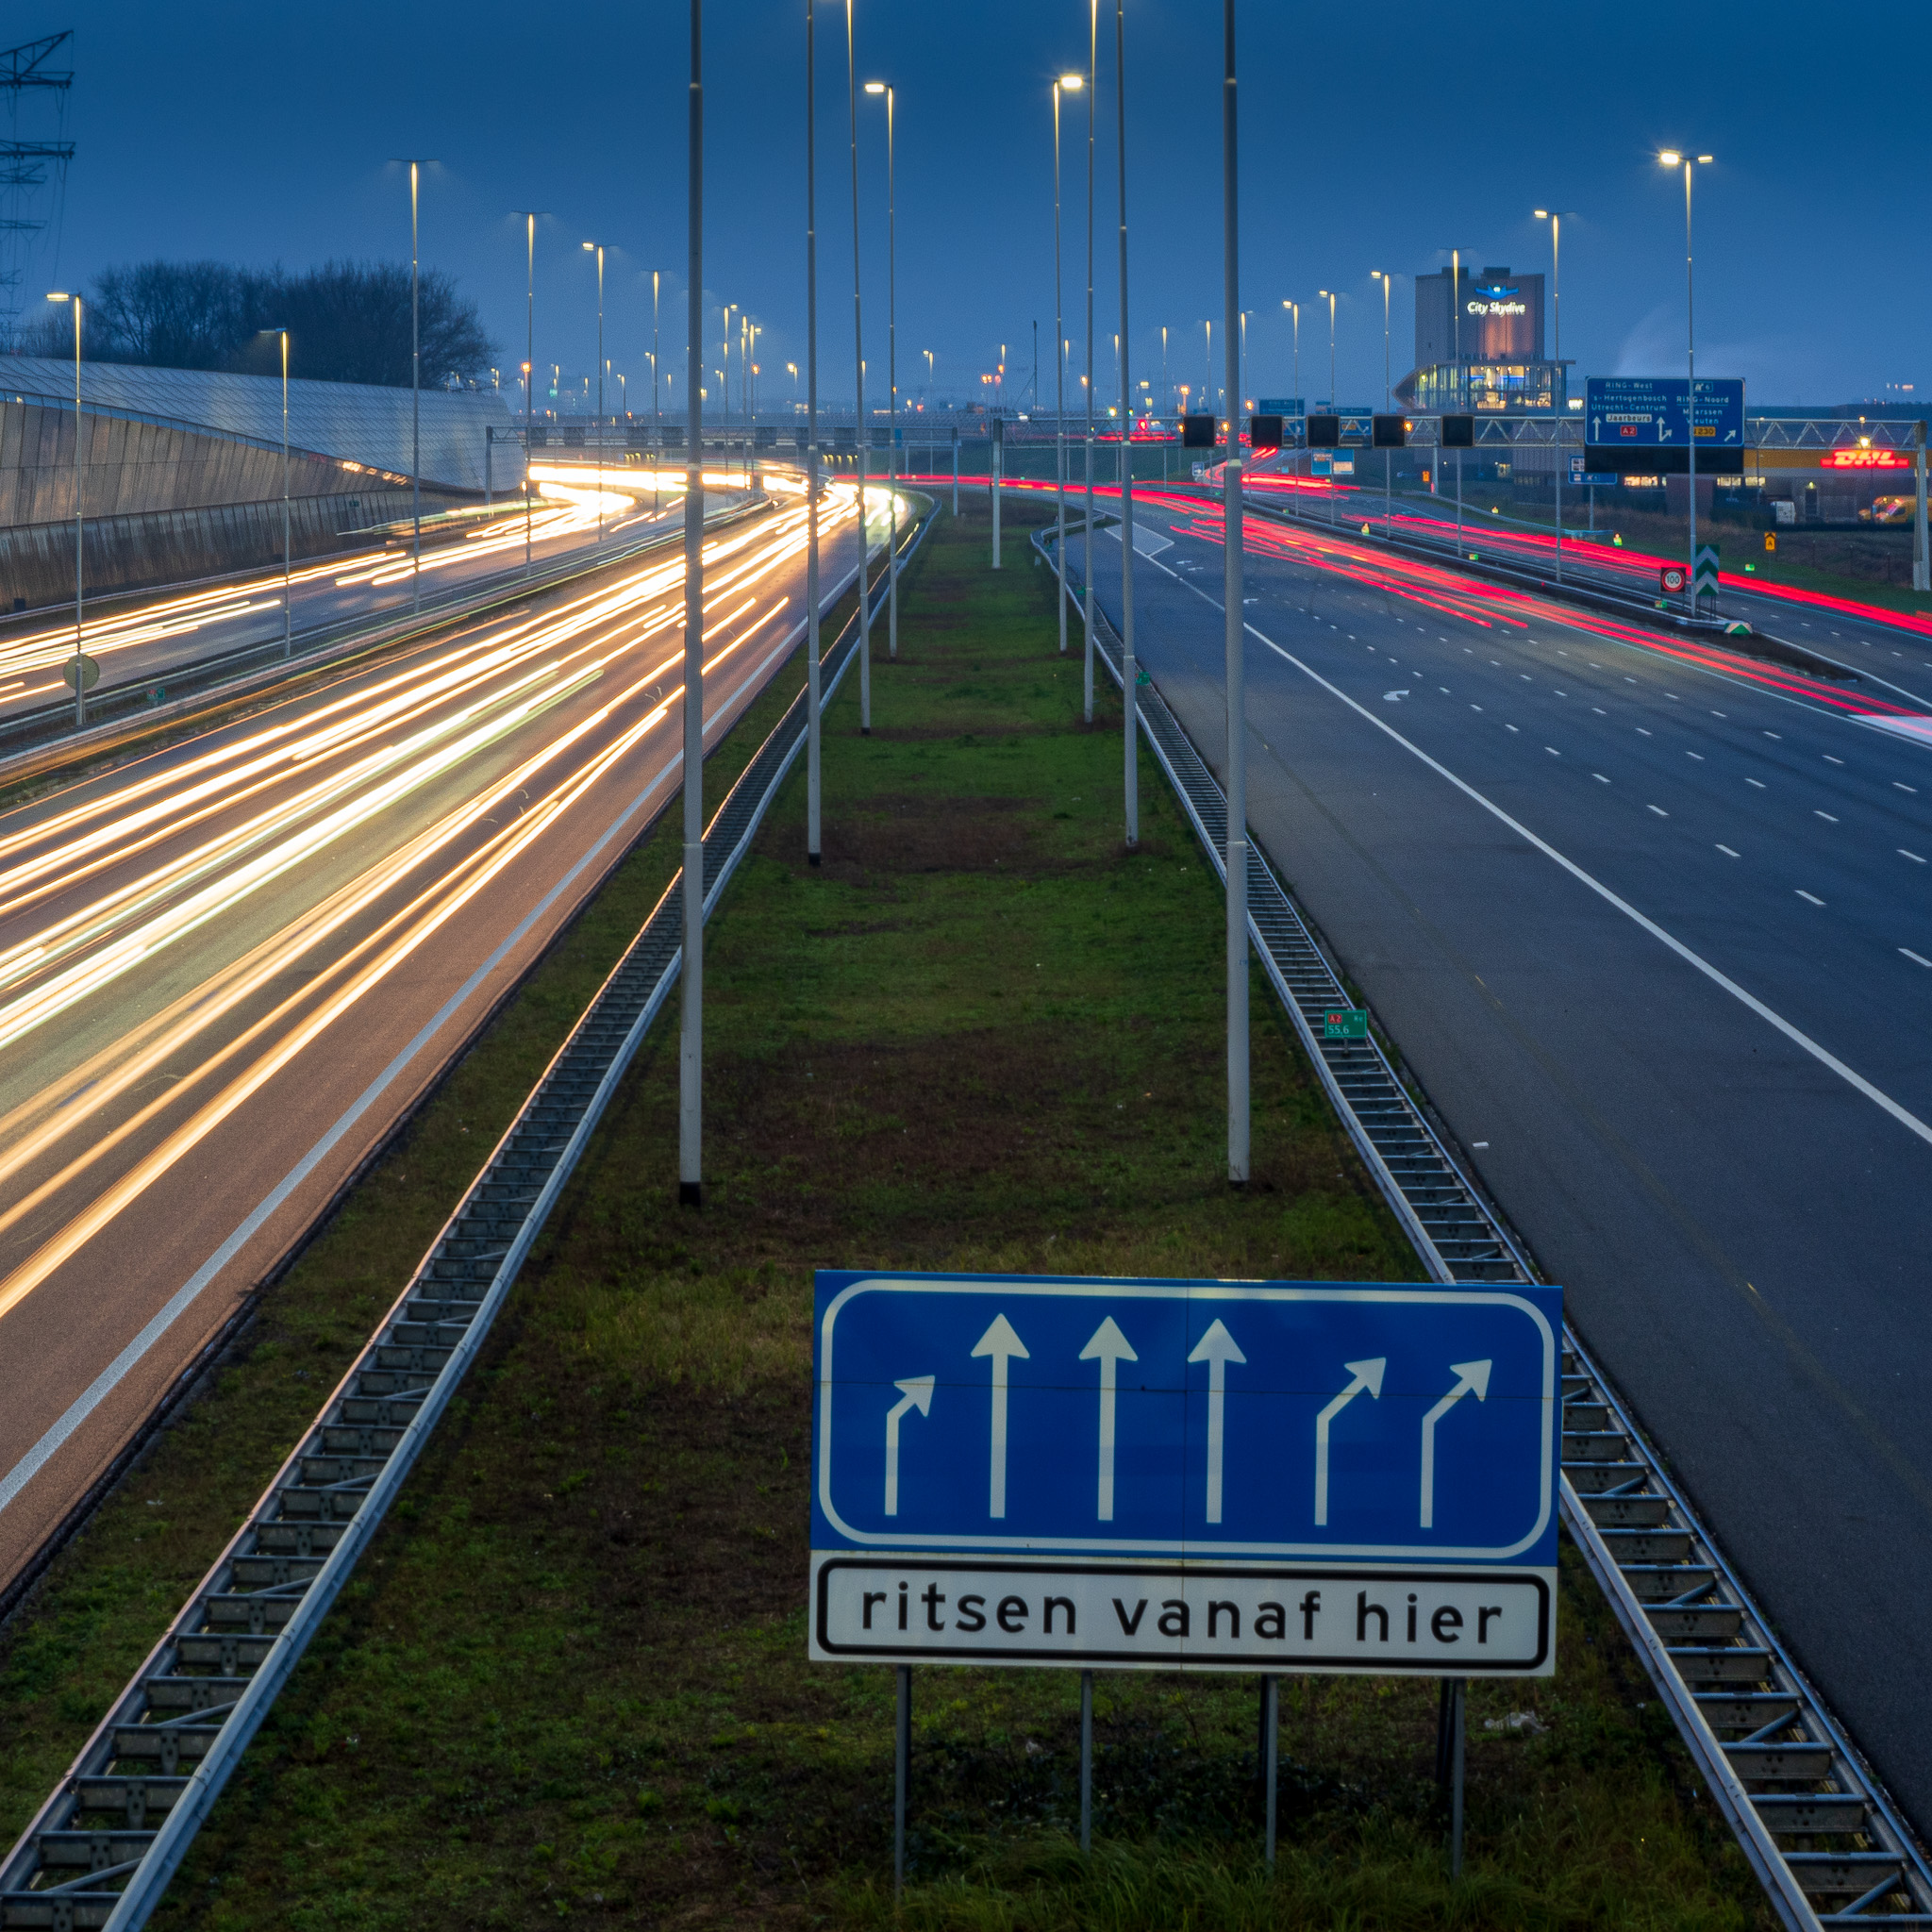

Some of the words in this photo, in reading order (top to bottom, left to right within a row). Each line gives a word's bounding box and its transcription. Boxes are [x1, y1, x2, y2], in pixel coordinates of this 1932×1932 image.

[1467, 302, 1488, 316] City
[1490, 302, 1525, 316] Skydive
[1833, 450, 1895, 467] DHL
[1666, 575, 1680, 584] 100
[1329, 1014, 1341, 1024] A2
[862, 1581, 1077, 1635] ritsen
[1112, 1590, 1322, 1641] vanaf
[1356, 1590, 1503, 1644] hier
